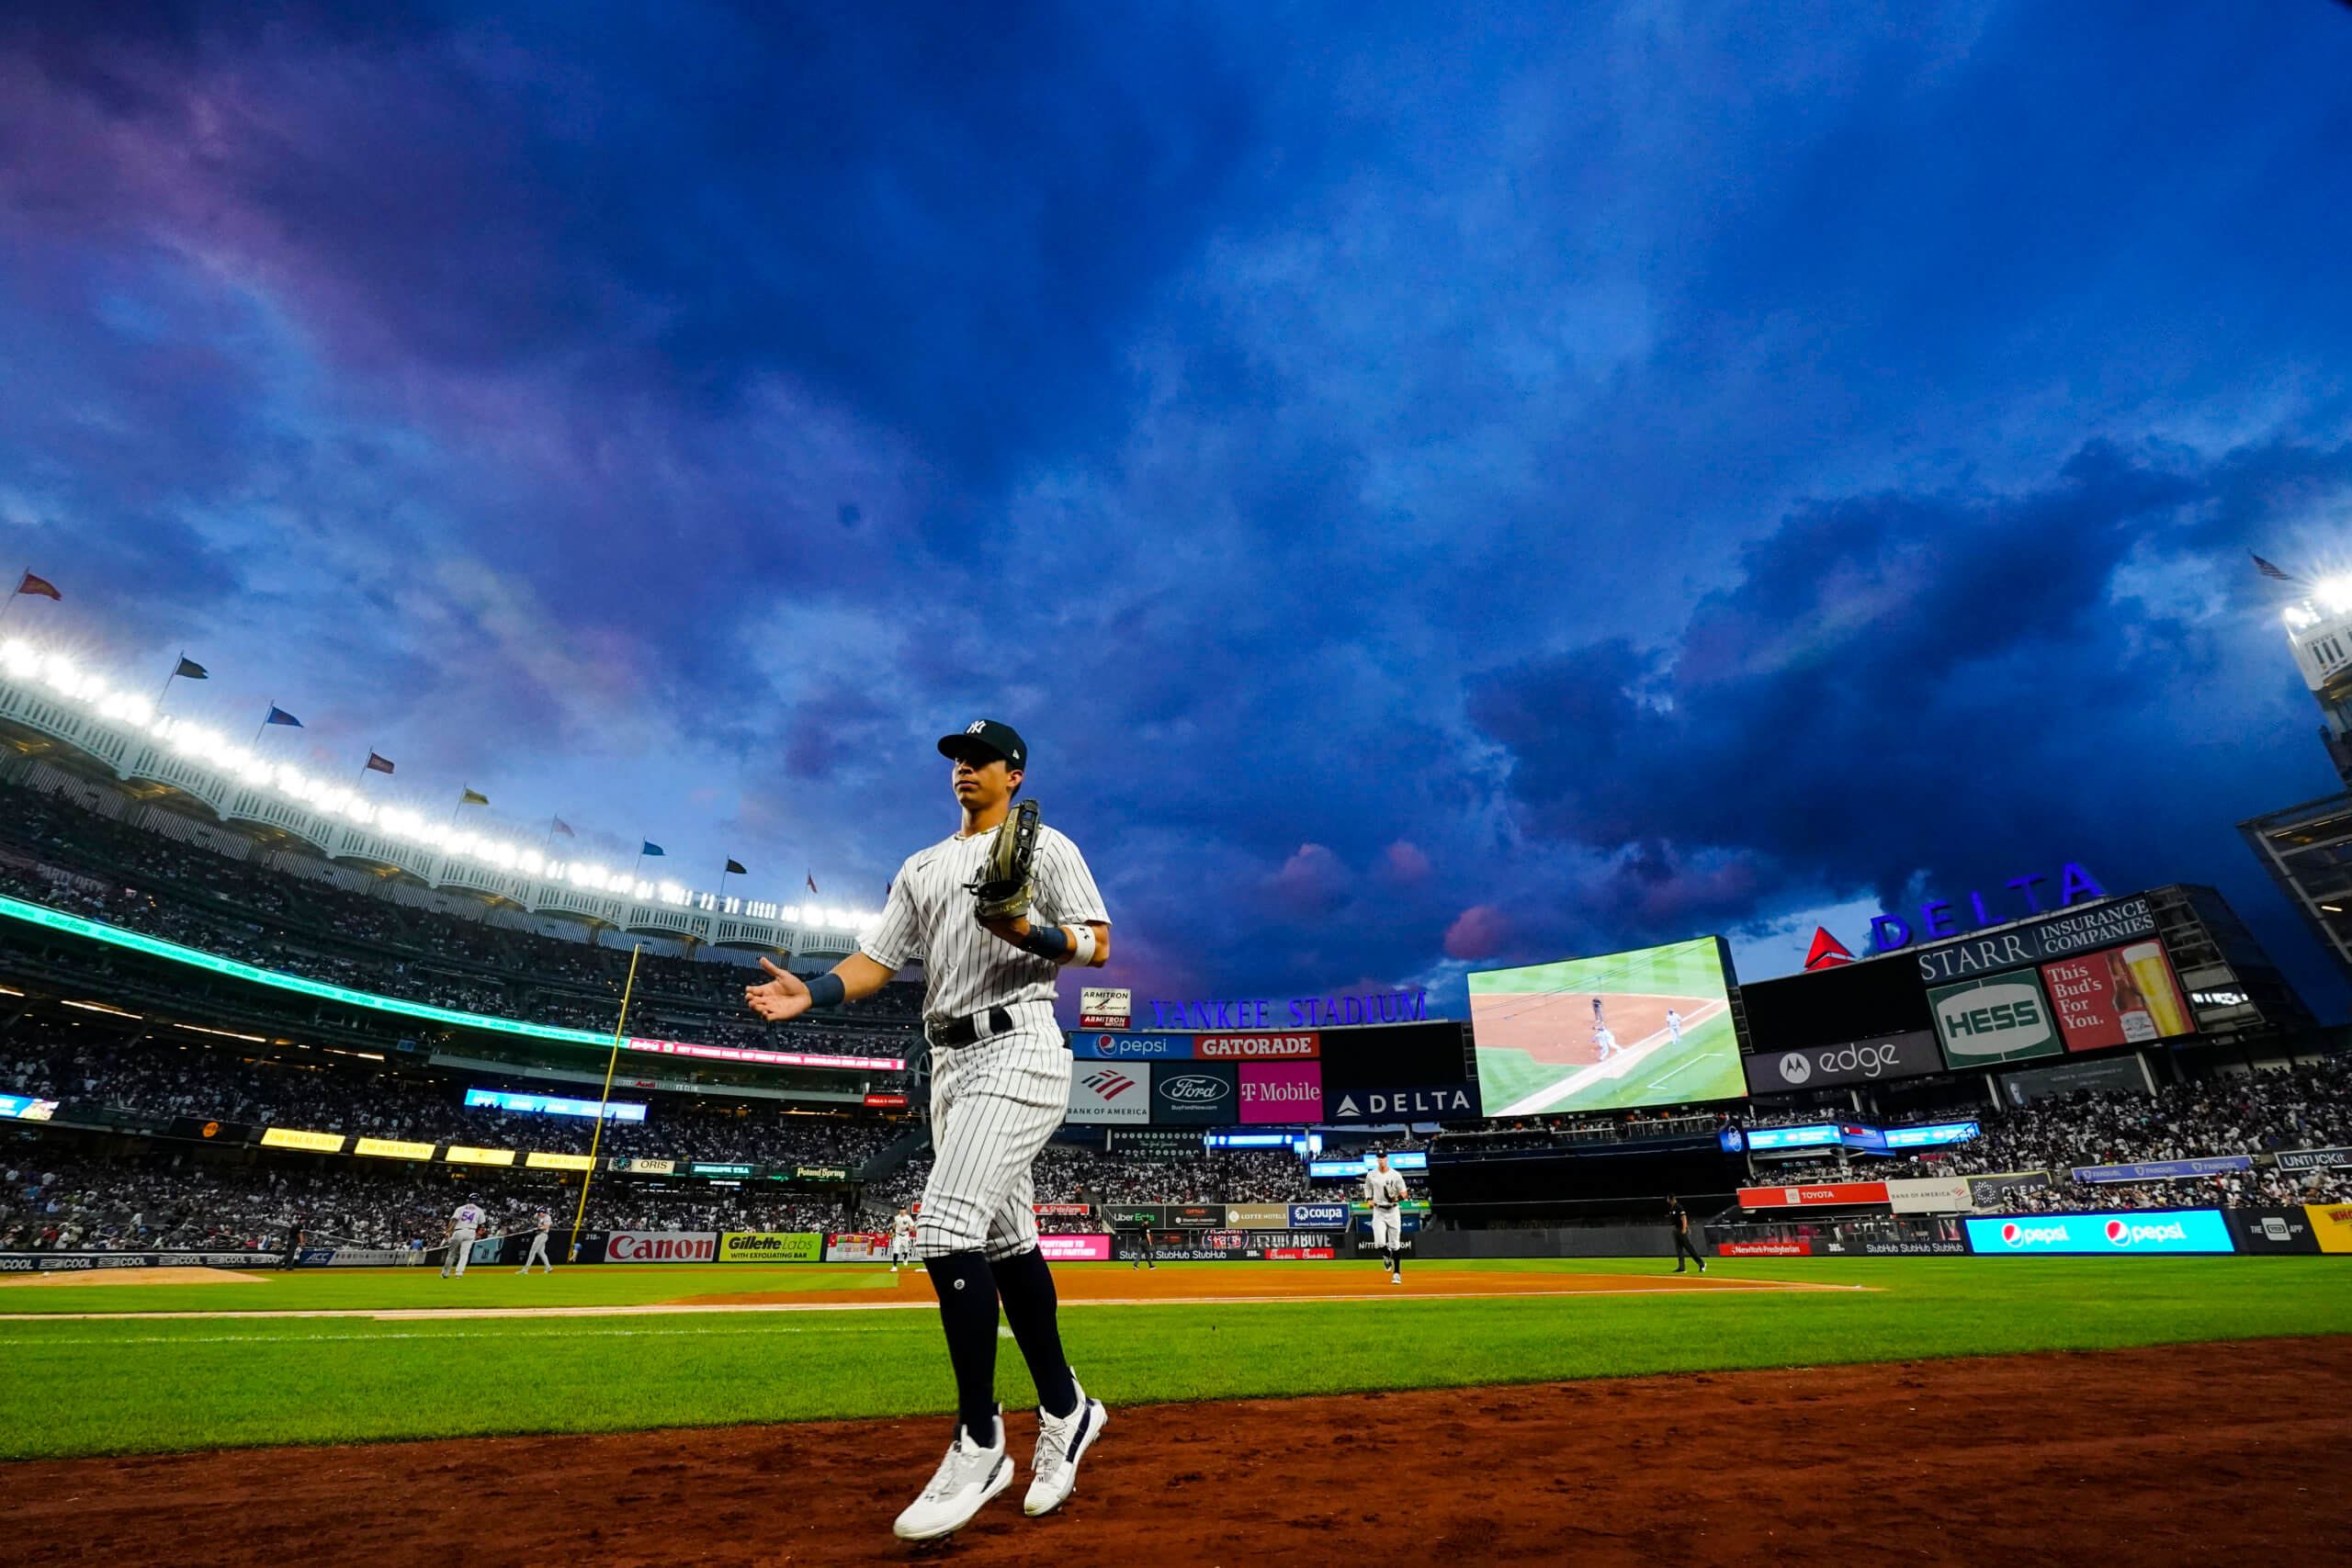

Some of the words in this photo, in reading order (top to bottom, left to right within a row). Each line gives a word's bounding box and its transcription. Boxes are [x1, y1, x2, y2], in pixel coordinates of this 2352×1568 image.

[1870, 861, 2106, 952] DELTA
[2041, 898, 2150, 940] INSURANCE
[2044, 914, 2154, 953] COMPANIES
[1918, 934, 2034, 981] STARR
[2047, 964, 2088, 983] This
[1083, 991, 1128, 999] ARMITRON
[2053, 977, 2103, 998] Bud's
[1149, 999, 1272, 1029] YANKEE
[1289, 991, 1428, 1028] STADIUM
[2059, 998, 2088, 1014] For
[1084, 1016, 1125, 1024] ARMITRON
[1945, 999, 2041, 1039] HESS
[2064, 1014, 2104, 1030] You.
[1119, 1038, 1167, 1055] pepsi
[1202, 1037, 1312, 1055] GATORADE
[1819, 1043, 1900, 1077] edge
[1171, 1077, 1217, 1098] Ford
[1259, 1081, 1320, 1101] Mobile
[1369, 1089, 1471, 1114] DELTA
[640, 1160, 668, 1169] ORIS
[2283, 1153, 2346, 1167] UNTUCKit
[797, 1168, 821, 1177] Poland
[821, 1168, 845, 1179] Spring
[460, 1212, 476, 1223] 54
[1114, 1213, 1135, 1222] Uber
[1309, 1208, 1342, 1221] coupa
[2024, 1225, 2067, 1244] pepsi
[2132, 1222, 2185, 1243] pepsi
[2249, 1224, 2264, 1234] THE
[2290, 1224, 2303, 1233] APP
[608, 1235, 713, 1259] Canon
[1156, 1250, 1190, 1259] StubHub
[1192, 1250, 1227, 1259] StubHub
[1866, 1244, 1899, 1253] StubHub
[1900, 1244, 1931, 1253] StubHub
[1932, 1243, 1964, 1252] StubHub
[2, 1258, 34, 1270] COOL
[64, 1258, 93, 1269] COOL
[119, 1257, 147, 1267] COOL
[179, 1256, 203, 1265] COOL
[224, 1255, 247, 1264] COOL
[306, 1252, 330, 1262] ACC
